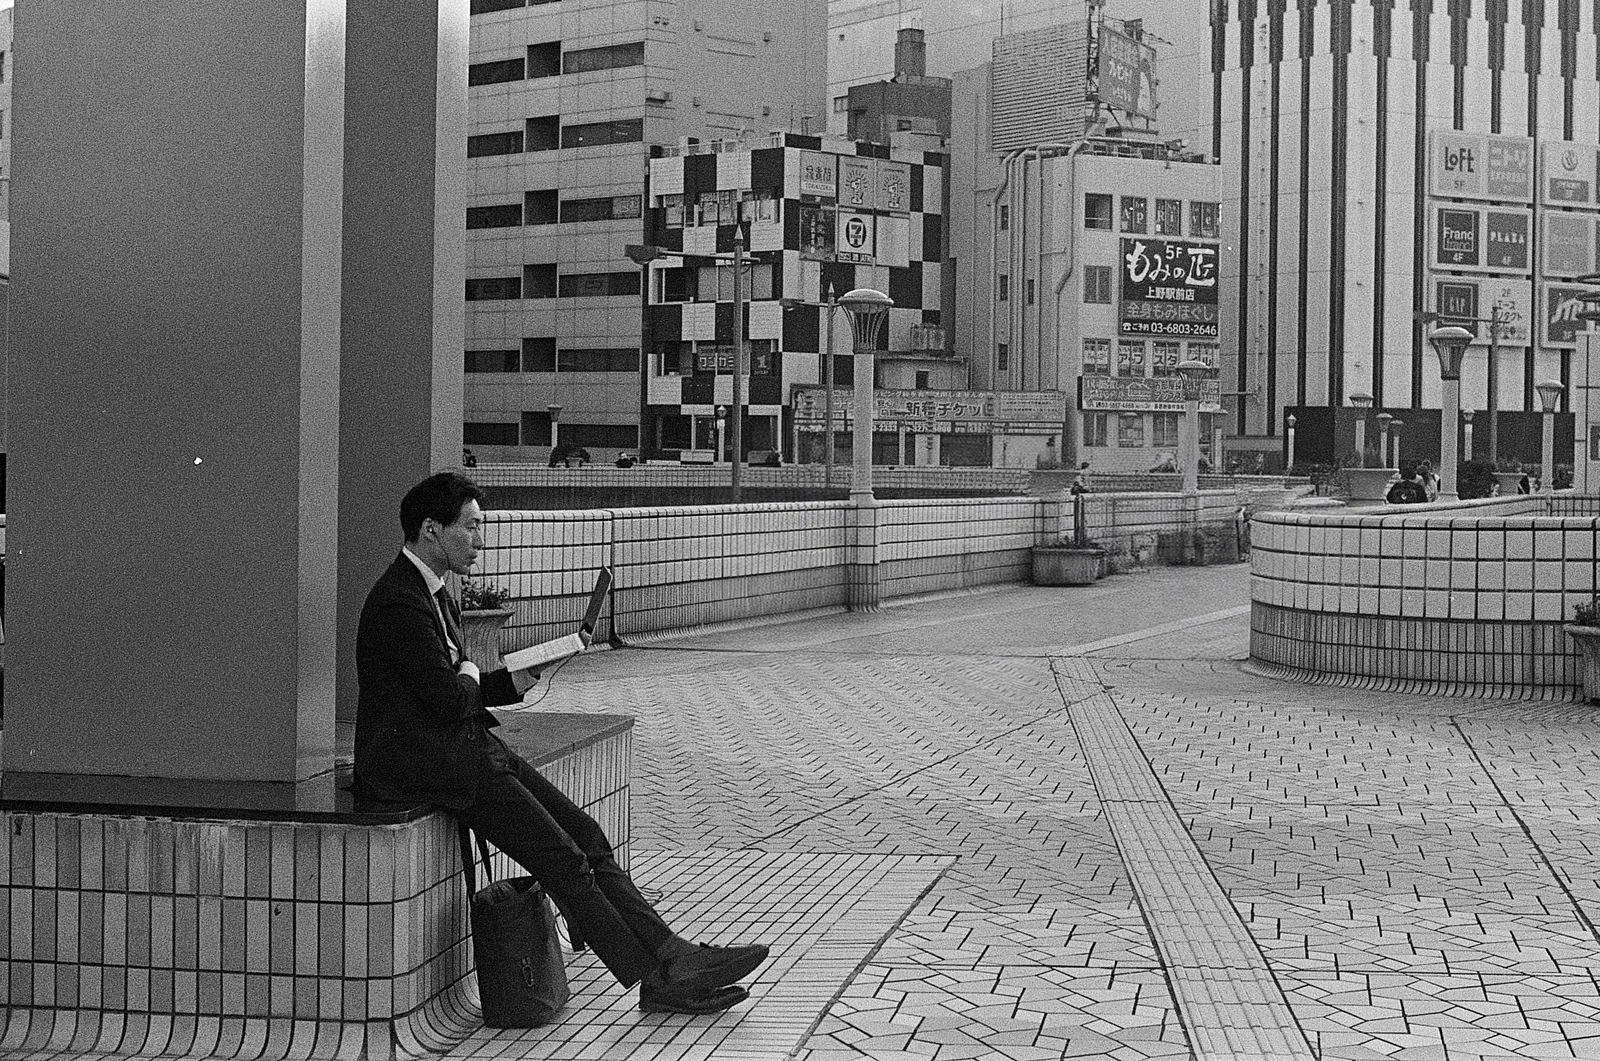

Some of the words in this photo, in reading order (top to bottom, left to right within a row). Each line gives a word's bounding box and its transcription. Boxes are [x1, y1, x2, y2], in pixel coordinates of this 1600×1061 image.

[1444, 227, 1474, 241] Franc
[1490, 231, 1525, 244] PLAZA
[1165, 245, 1182, 259] 5F
[1452, 252, 1464, 263] 4F
[1126, 241, 1215, 287] もみの匠
[1145, 286, 1195, 300] 上野駅前店
[1127, 302, 1213, 320] 全身もみほぐし
[1151, 322, 1217, 335] 03-6803-2646
